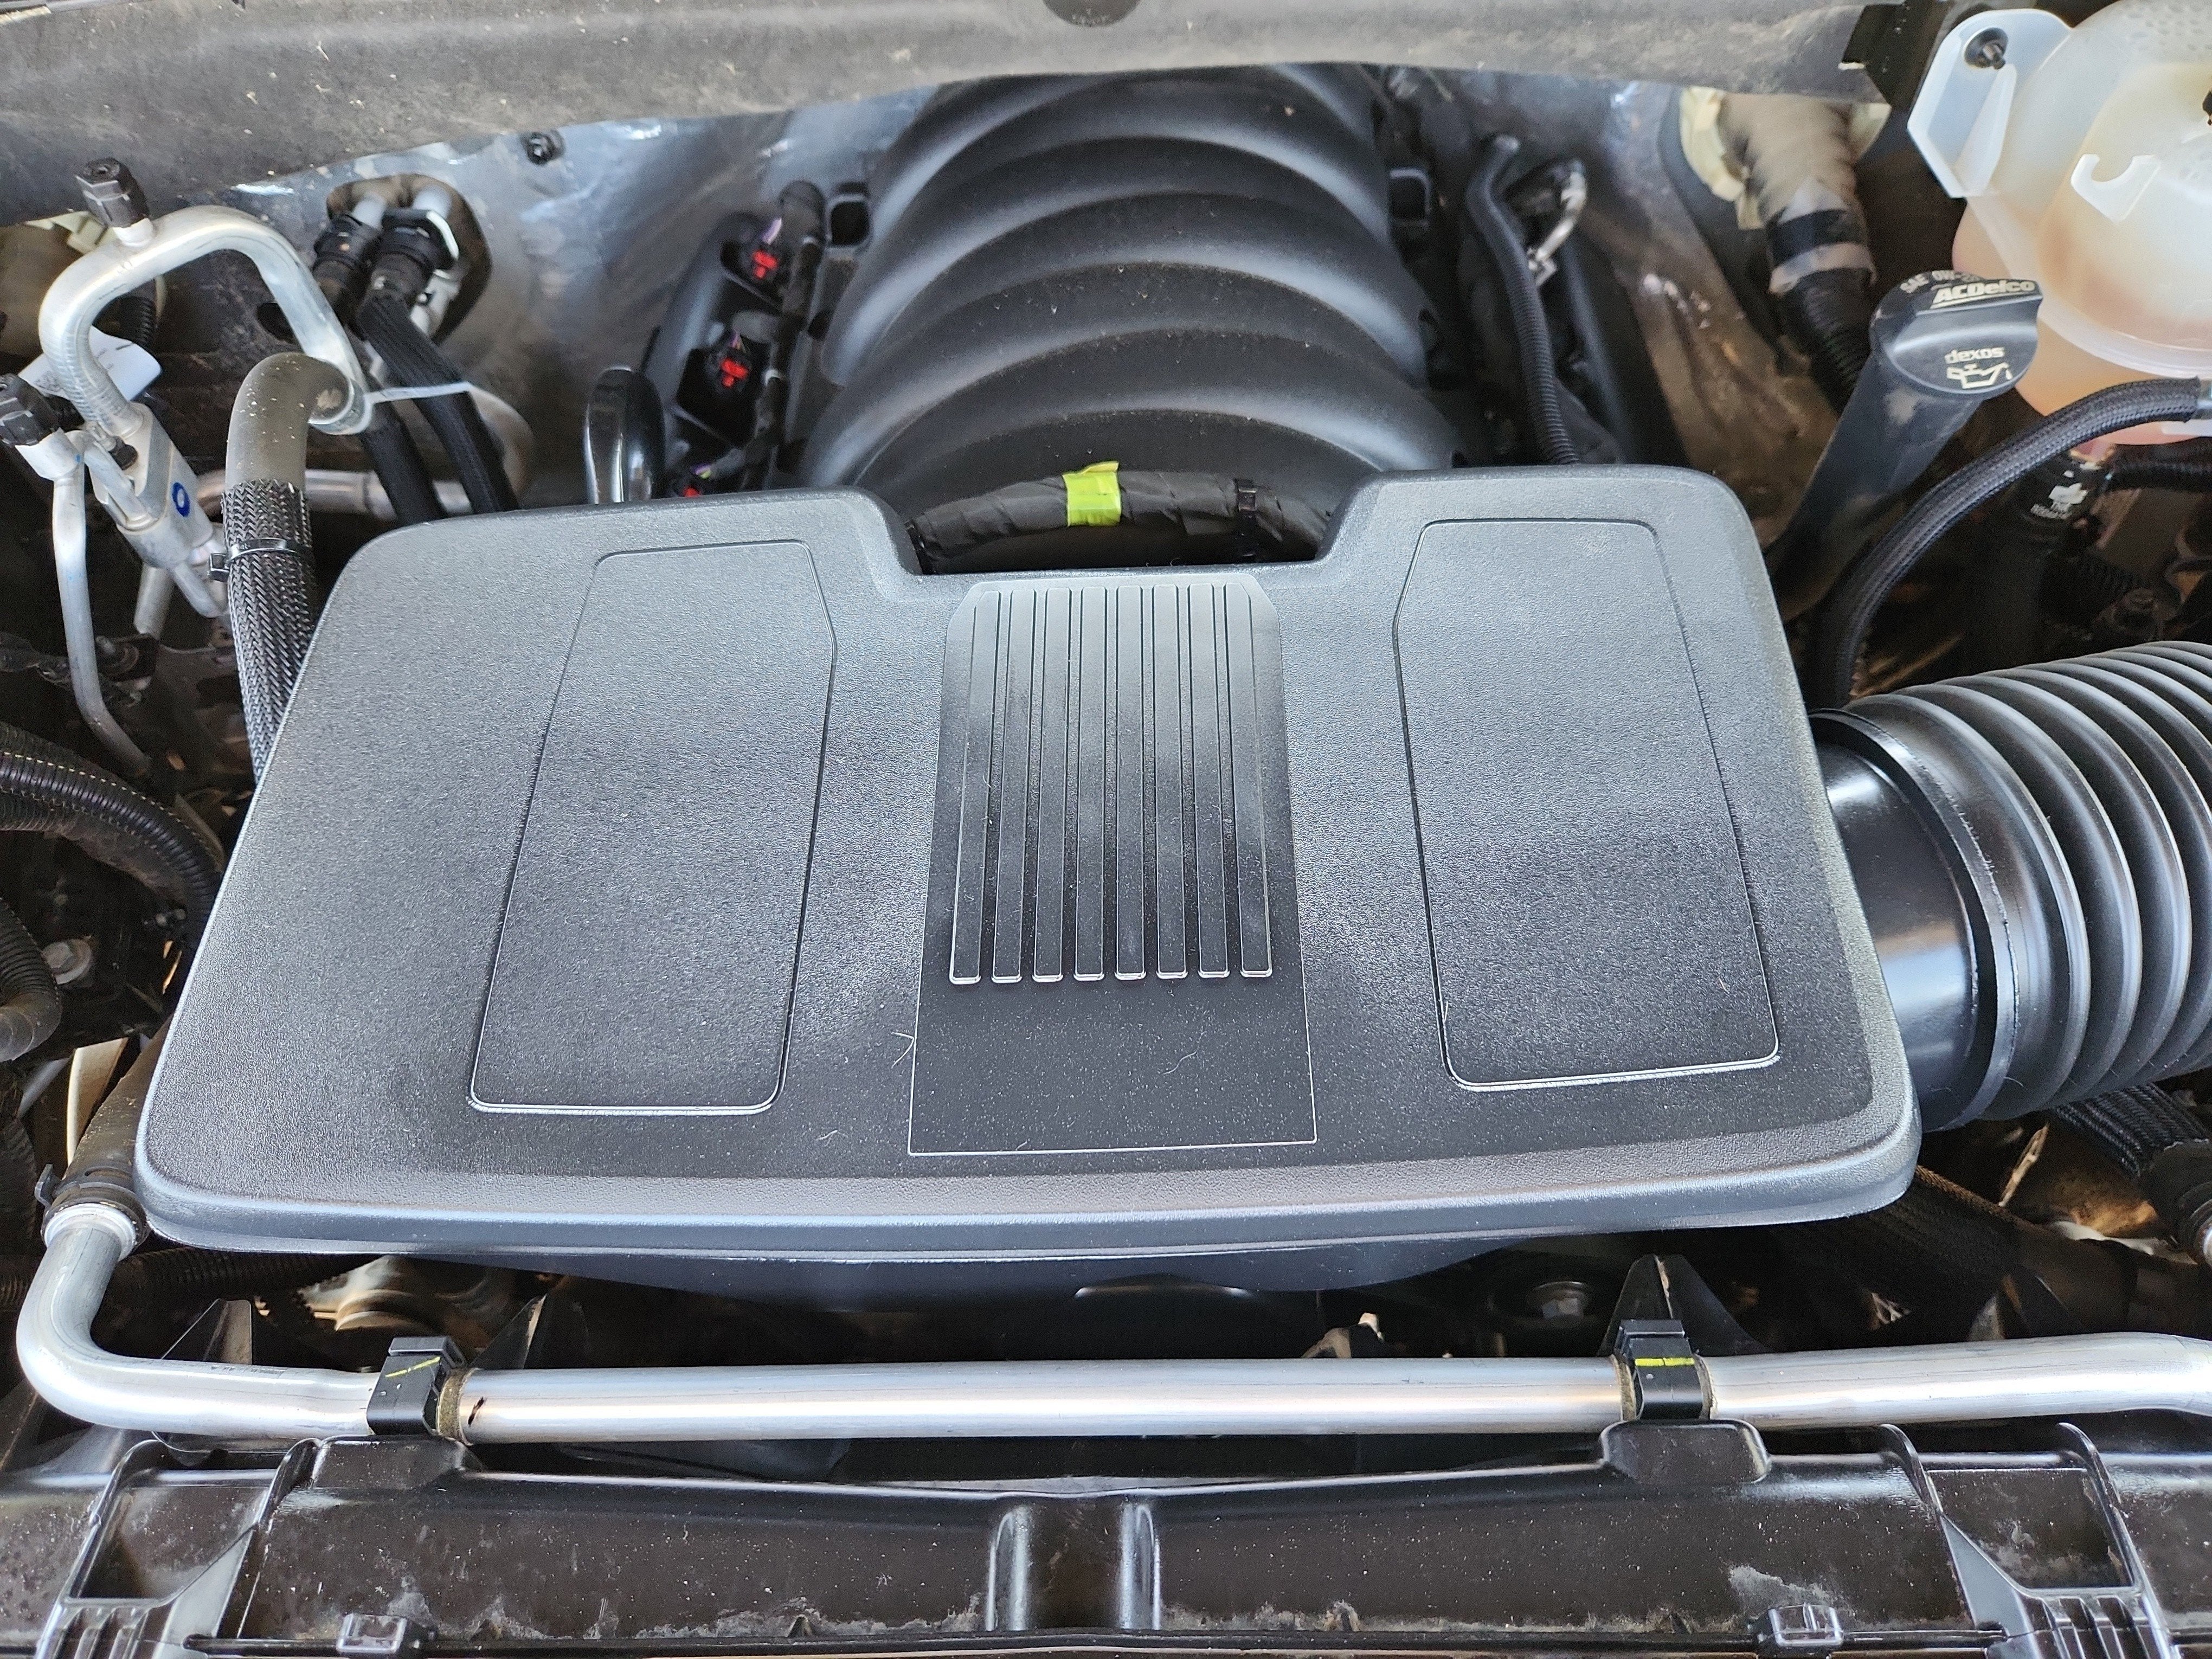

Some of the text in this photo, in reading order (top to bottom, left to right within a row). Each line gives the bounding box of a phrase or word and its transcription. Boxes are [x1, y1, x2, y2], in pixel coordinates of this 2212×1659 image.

[1899, 273, 1929, 293] SAE
[1933, 279, 2036, 304] ACDelco
[1944, 346, 2005, 364] dexos
